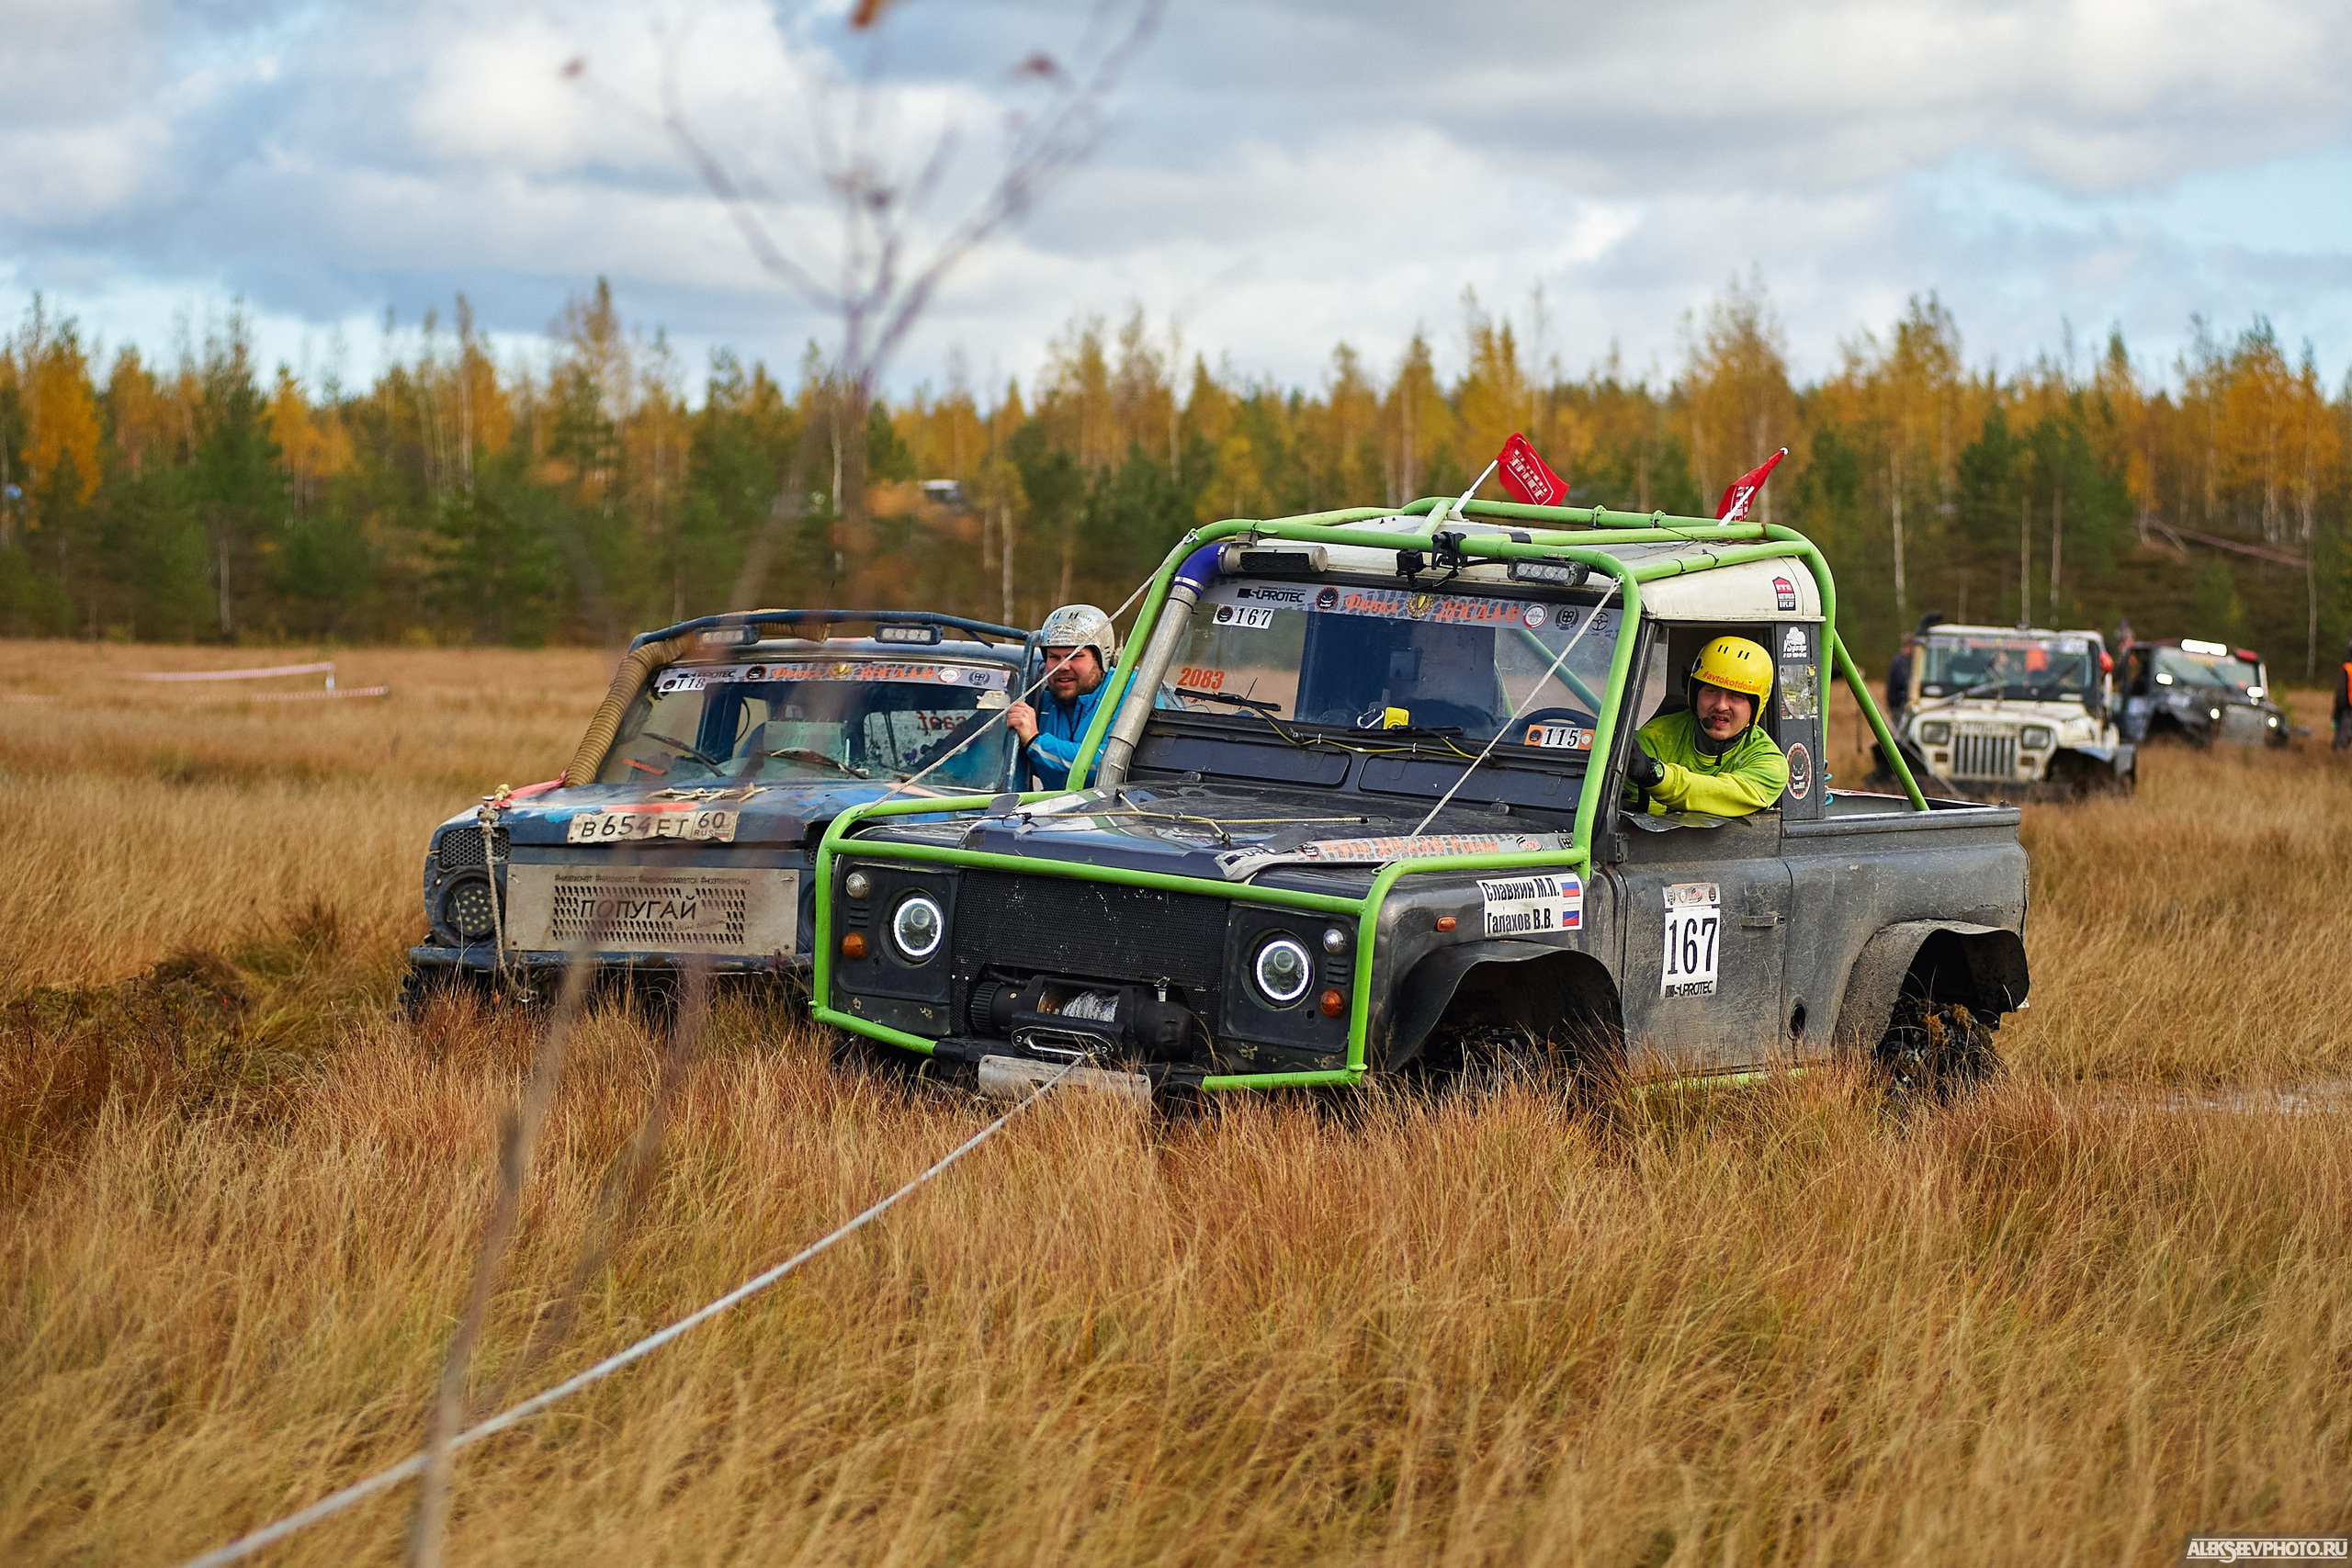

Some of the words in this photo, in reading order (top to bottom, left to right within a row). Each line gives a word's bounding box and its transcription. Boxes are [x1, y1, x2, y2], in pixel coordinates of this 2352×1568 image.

[1250, 588, 1306, 604] SUPROTEC
[1236, 607, 1272, 626] 167
[1344, 592, 1398, 614] Финал
[1435, 600, 1521, 624] ДОСААФ
[678, 679, 705, 690] 118
[1177, 667, 1225, 690] 2083
[1544, 728, 1578, 747] 115
[698, 812, 725, 829] 60
[694, 829, 714, 837] RUS
[1481, 880, 1535, 902] Славкин
[1533, 877, 1560, 898] М.П.
[581, 895, 696, 919] ПОПУГАЙ
[1487, 912, 1531, 934] Галахов
[1532, 908, 1554, 930] В.В.
[1668, 918, 1717, 975] 167
